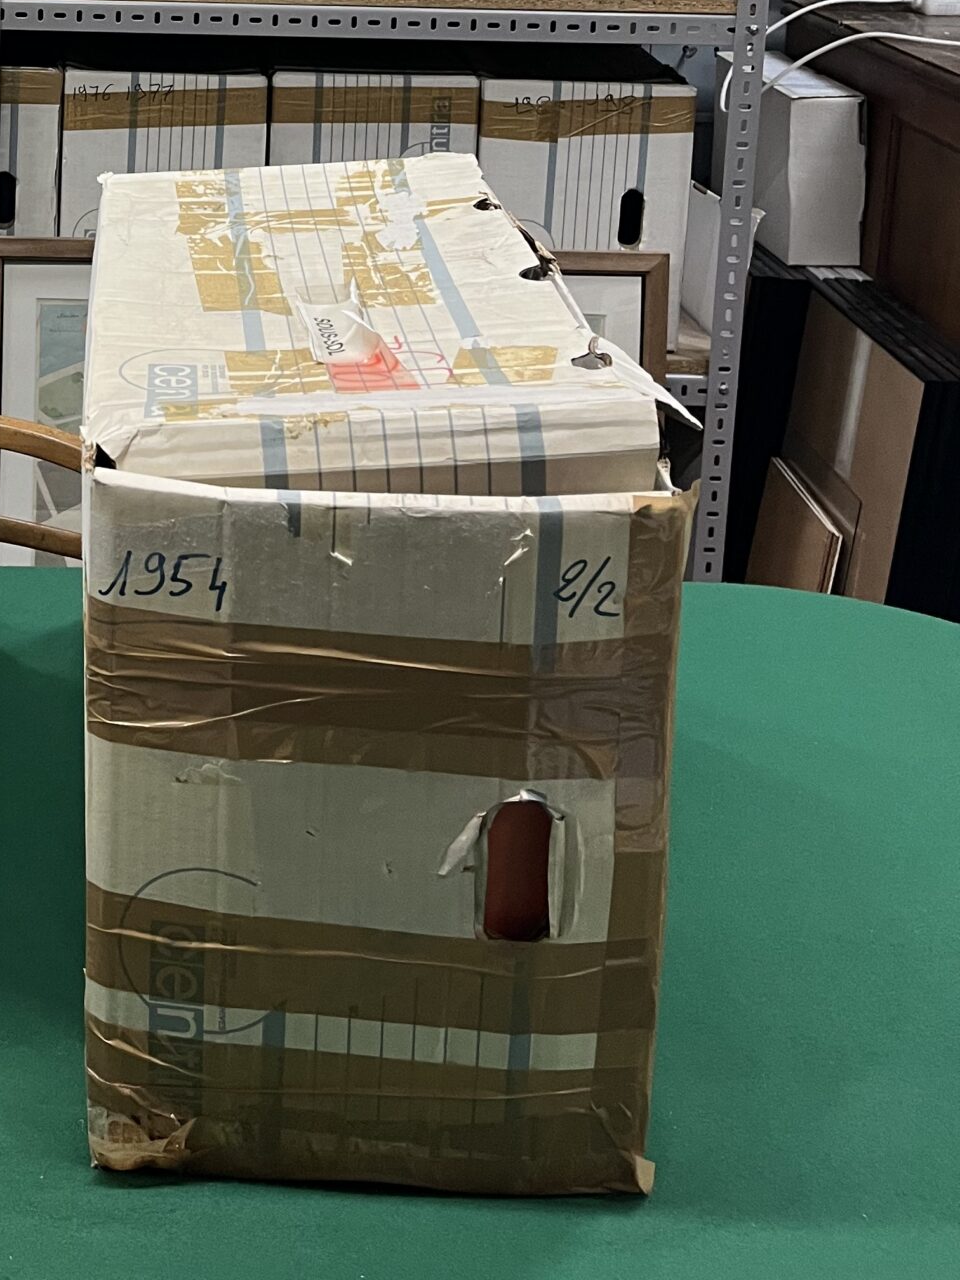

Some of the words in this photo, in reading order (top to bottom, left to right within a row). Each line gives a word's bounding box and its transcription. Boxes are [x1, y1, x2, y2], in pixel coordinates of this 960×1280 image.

[72, 83, 115, 103] 1976
[126, 83, 175, 103] 1977
[96, 550, 232, 612] 1954
[553, 557, 621, 618] 2/2
